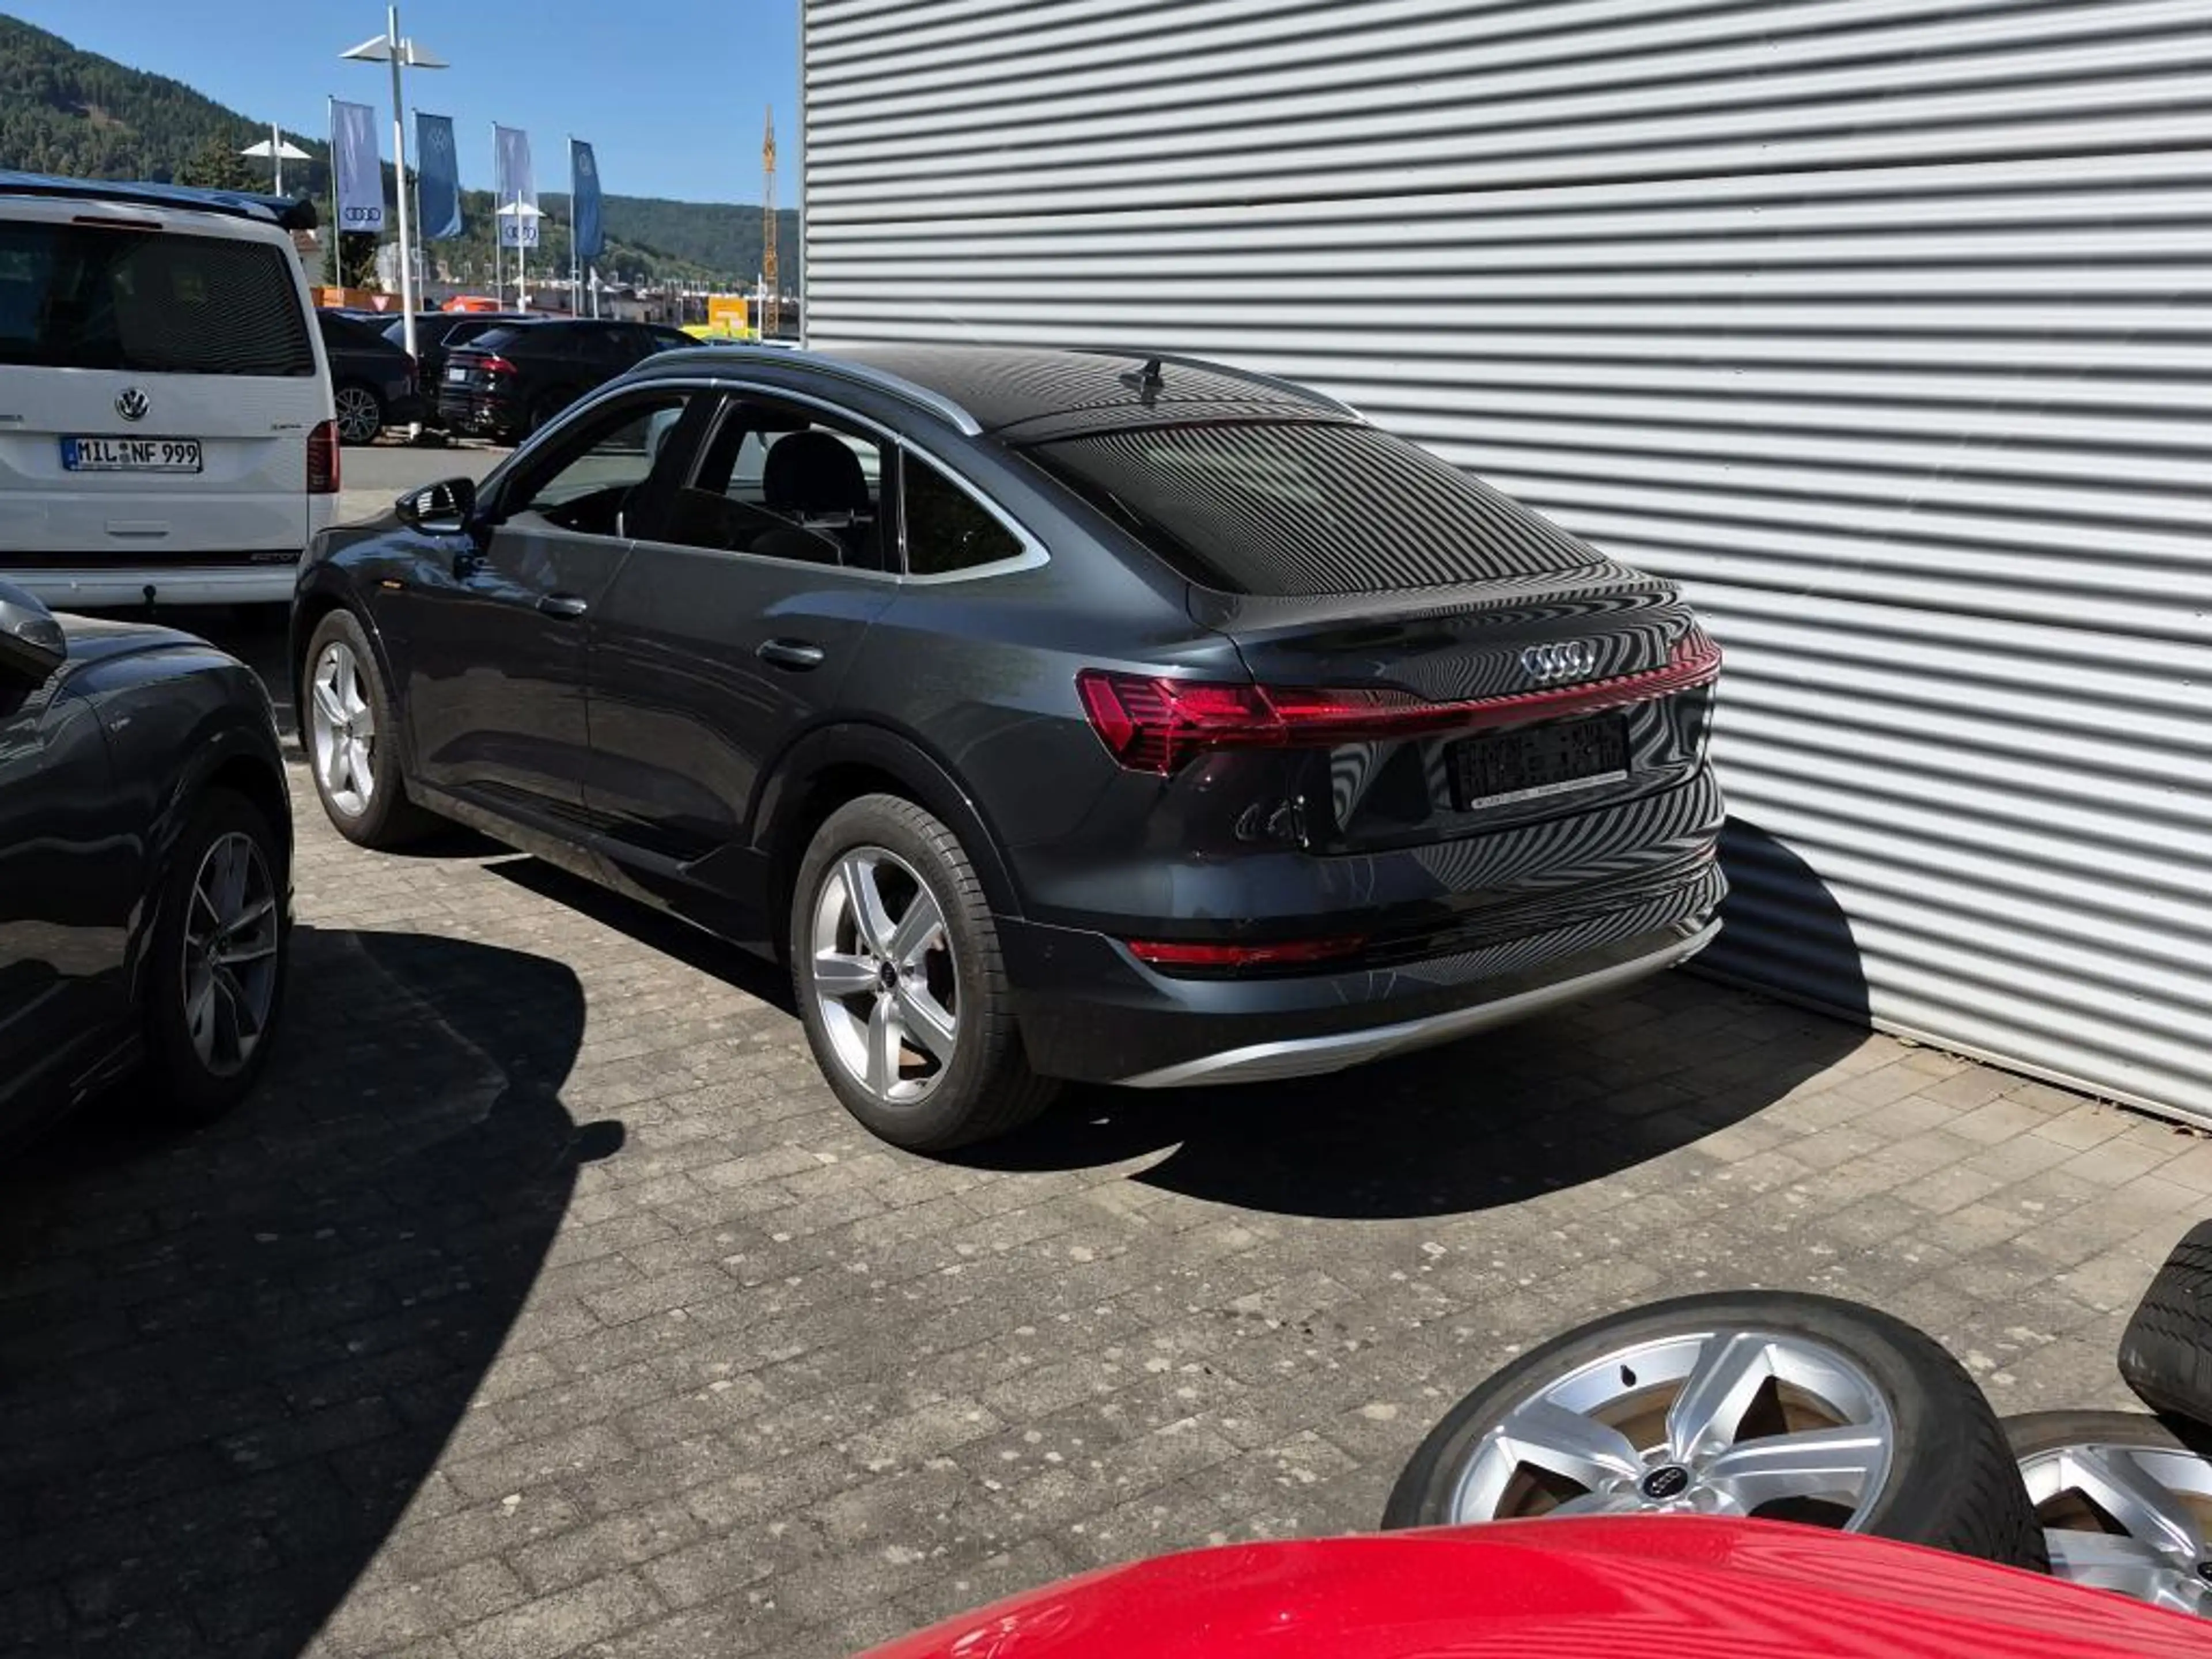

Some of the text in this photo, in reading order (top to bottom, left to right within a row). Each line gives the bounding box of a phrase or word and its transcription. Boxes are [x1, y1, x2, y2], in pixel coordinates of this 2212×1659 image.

[78, 441, 118, 462] MIL
[131, 443, 156, 463] NF
[163, 444, 196, 463] 999
